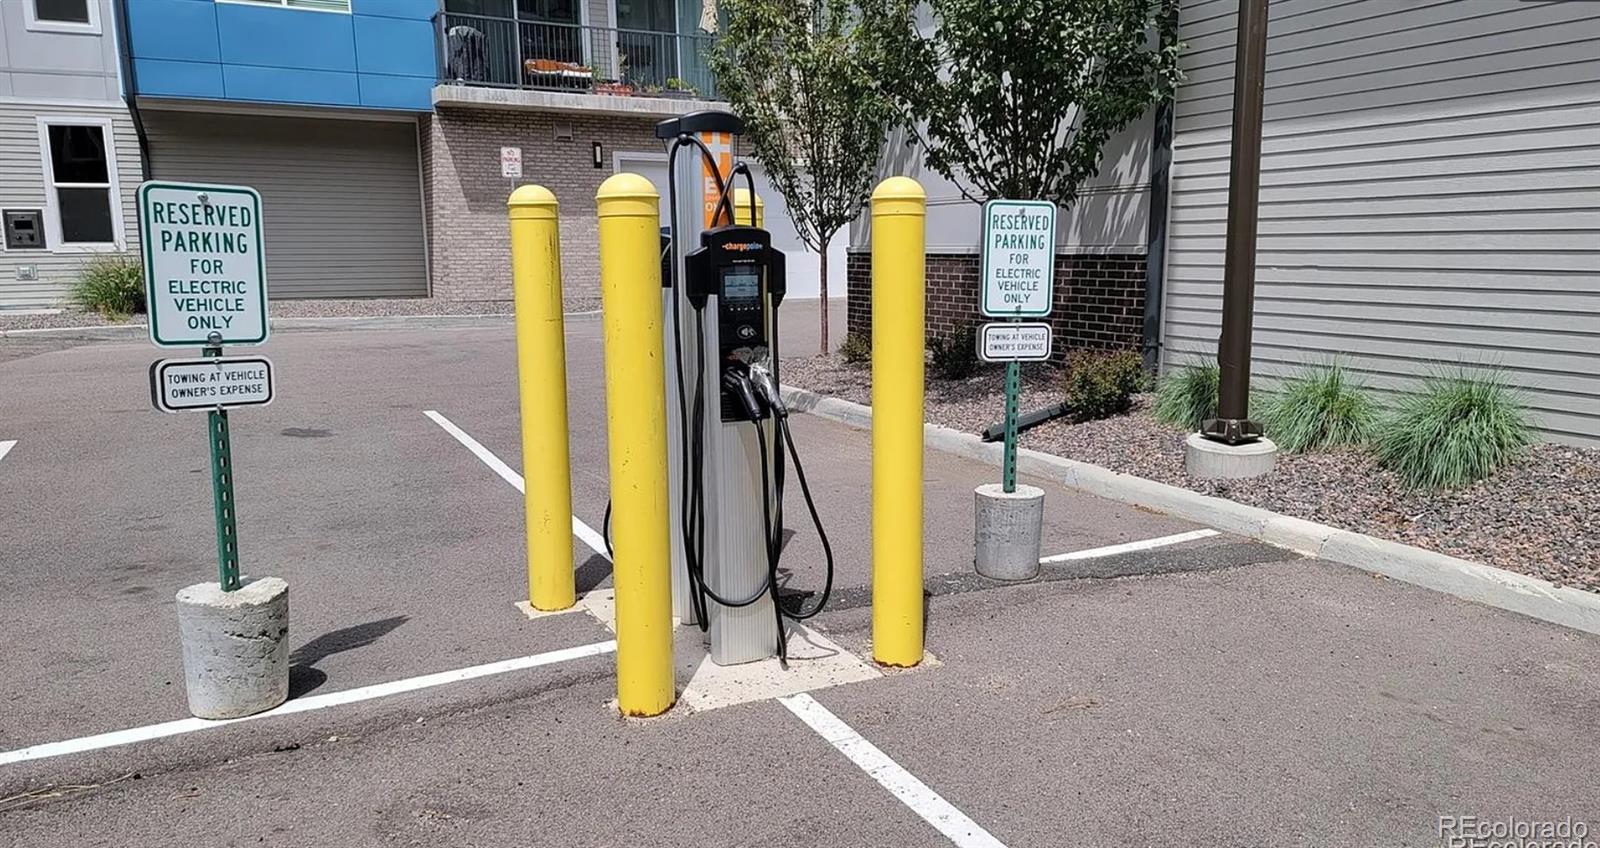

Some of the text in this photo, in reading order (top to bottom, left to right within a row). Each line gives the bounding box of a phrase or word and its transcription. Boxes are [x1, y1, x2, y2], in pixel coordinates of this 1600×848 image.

[153, 201, 251, 227] RESERVED
[992, 214, 1049, 231] RESERVED
[161, 230, 247, 254] PARKING
[994, 233, 1045, 250] PARKING
[1009, 253, 1029, 265] FOR
[190, 259, 223, 275] FOR
[995, 268, 1041, 279] ELECTRIC
[168, 280, 247, 294] ELECTRIC
[997, 281, 1039, 291] VEHICLE
[173, 298, 245, 312] VEHICLE
[1003, 293, 1031, 304] ONLY
[187, 315, 233, 330] ONLY
[988, 333, 1010, 341] TOWING
[1021, 333, 1045, 341] VEHICLE
[989, 343, 1043, 351] OWNER'S EXPENSE
[167, 370, 265, 384] TOWING AT VEHICLE
[171, 384, 263, 398] OWNER'S EXPENSE
